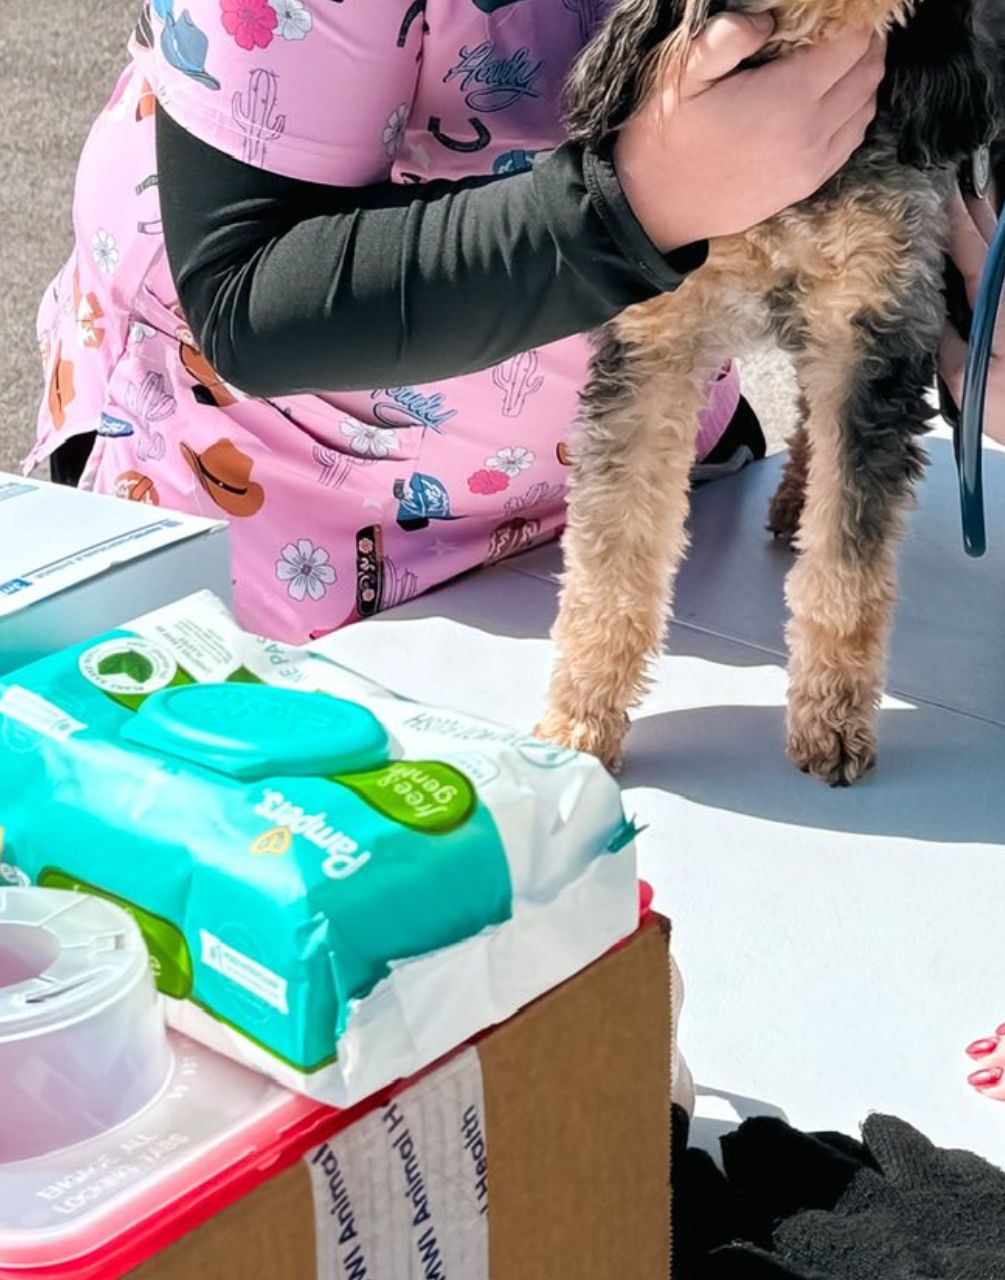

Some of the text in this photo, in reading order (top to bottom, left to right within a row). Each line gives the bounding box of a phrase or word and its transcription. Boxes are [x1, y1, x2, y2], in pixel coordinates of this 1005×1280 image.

[253, 788, 373, 880] Pampers
[312, 1142, 368, 1280] WI Animal
[392, 1128, 431, 1226] Animal
